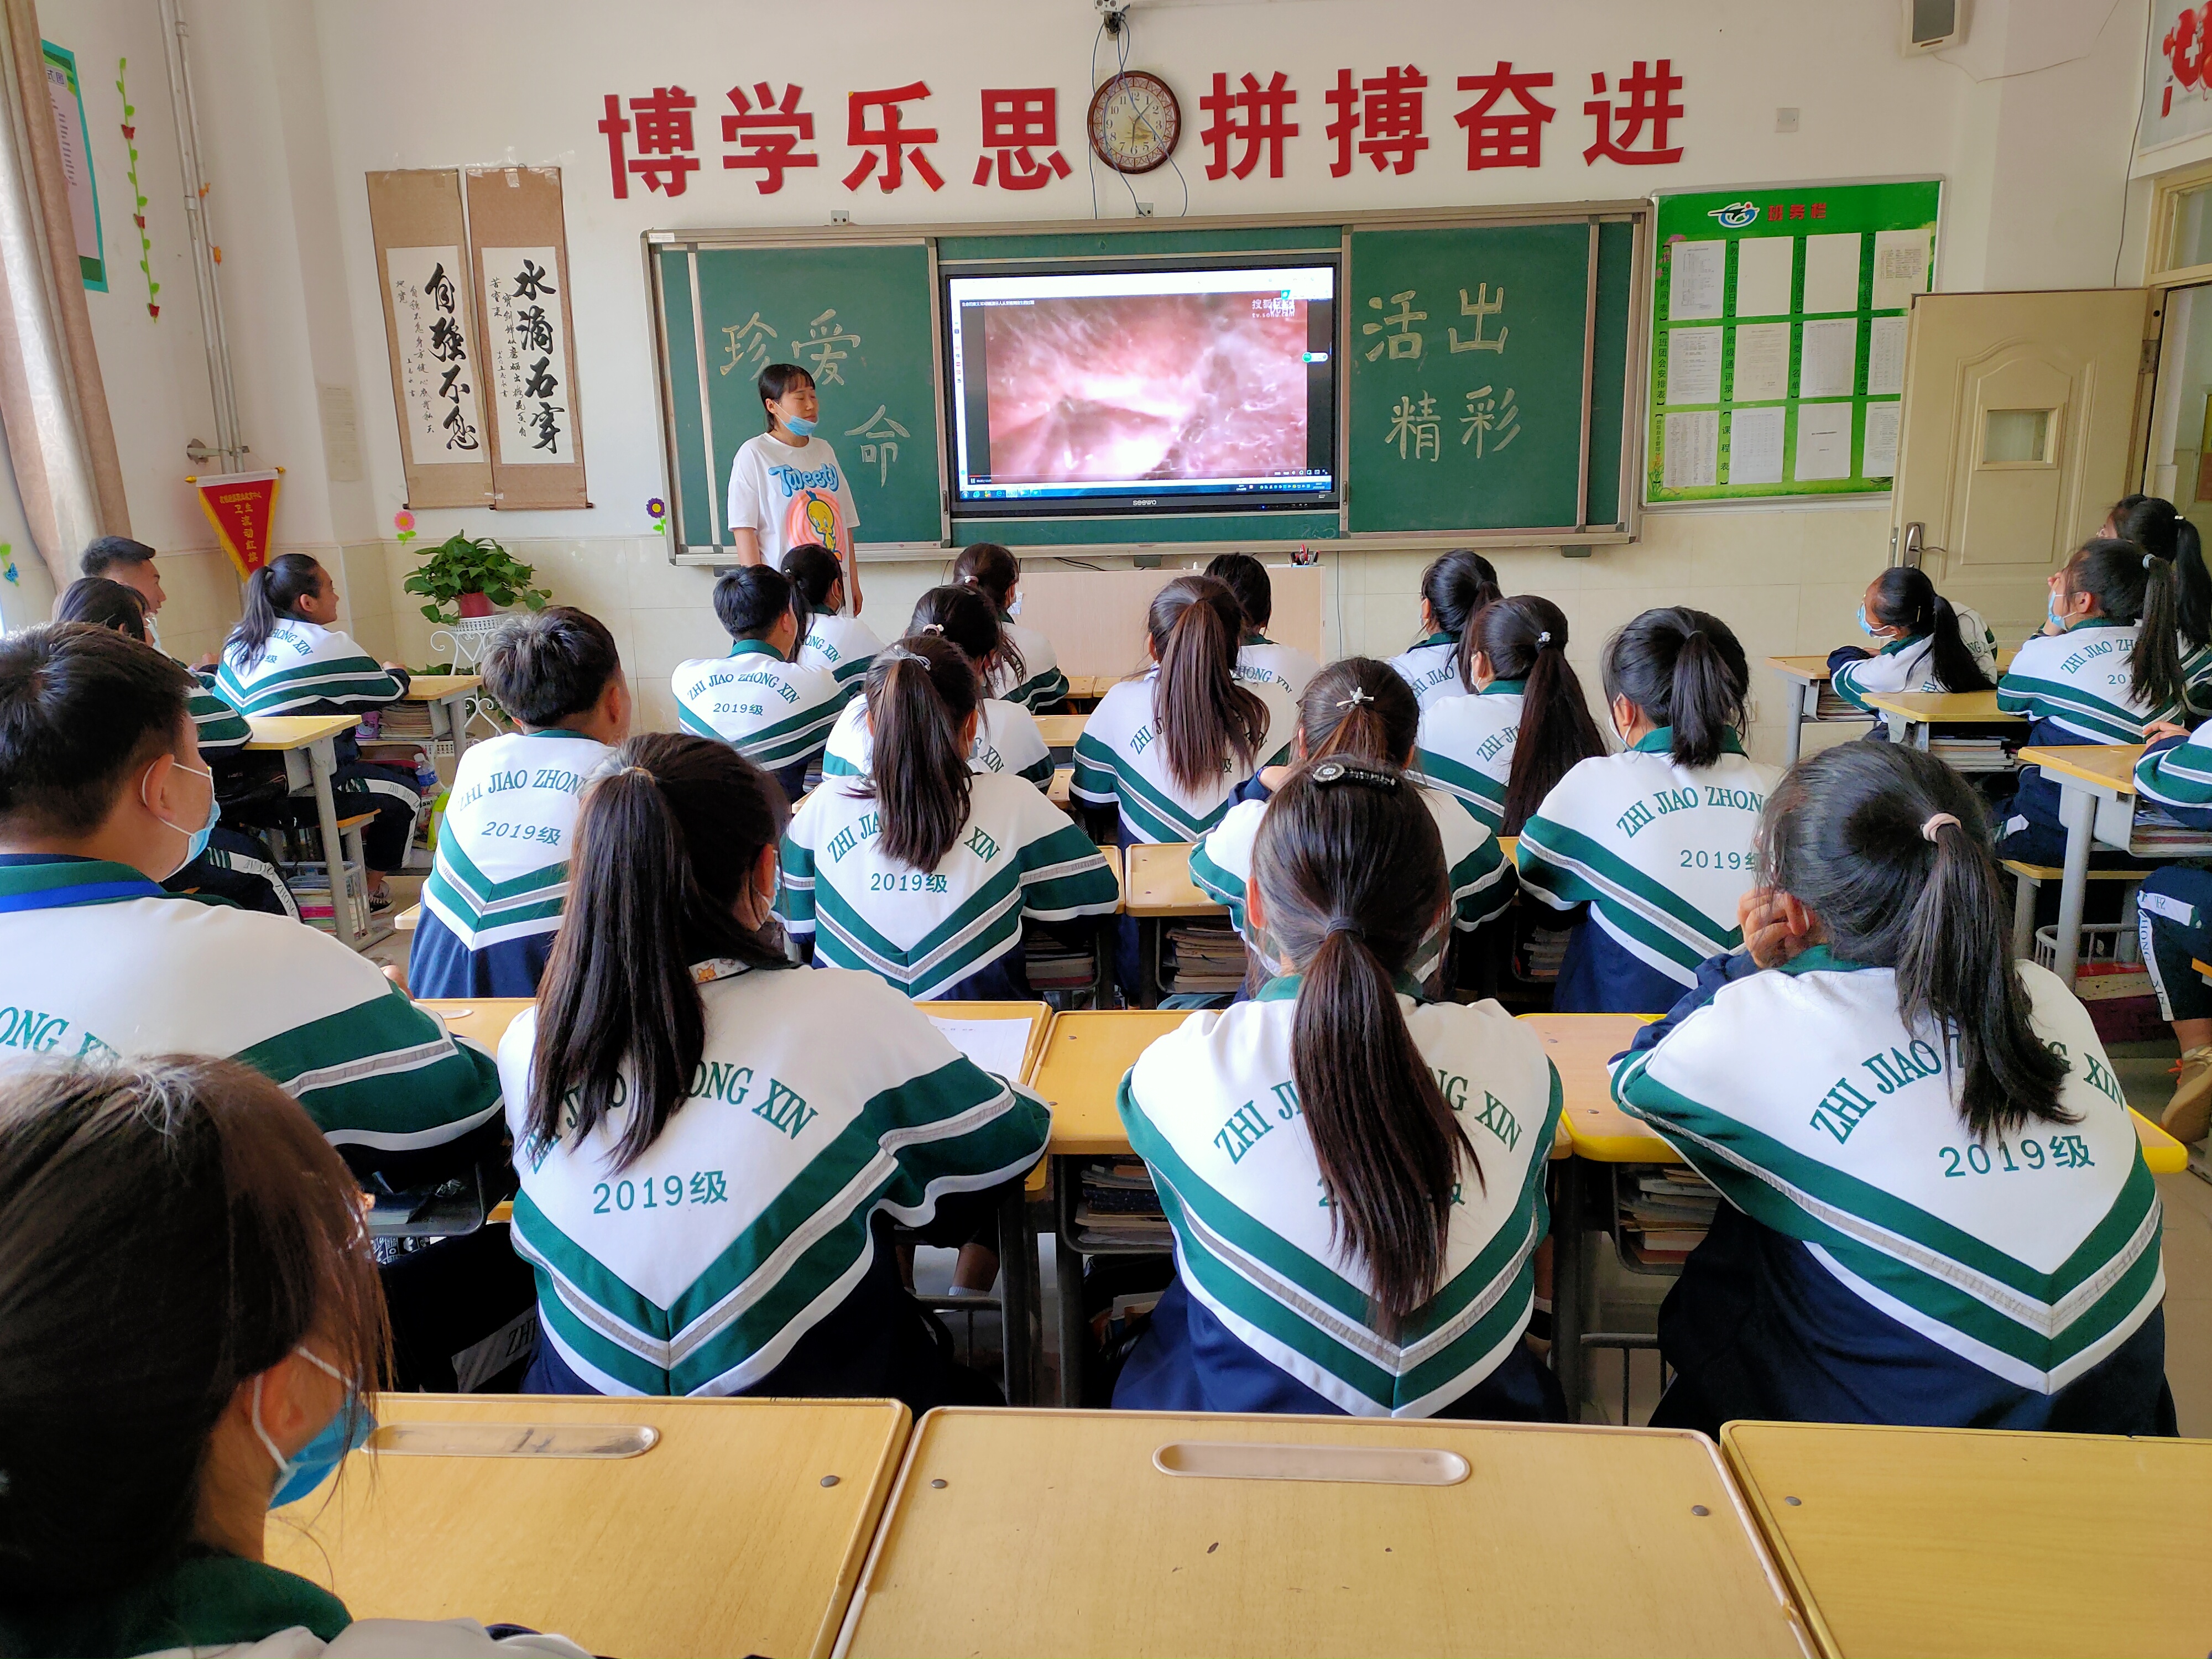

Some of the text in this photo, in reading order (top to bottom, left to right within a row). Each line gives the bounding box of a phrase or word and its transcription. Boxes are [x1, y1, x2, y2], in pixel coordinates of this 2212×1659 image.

[1120, 96, 1126, 105] 11
[1145, 96, 1149, 105] 1
[1152, 106, 1159, 114] 2
[598, 59, 1685, 199] 博学乐思 拼搏奋进
[1106, 119, 1113, 128] 9
[1110, 132, 1117, 141] 8
[1156, 121, 1162, 129] 3
[1119, 142, 1125, 151] 7
[1130, 145, 1138, 154] 6
[1142, 142, 1149, 150] 5
[1768, 203, 1826, 221] 班务栏
[1363, 283, 1509, 362] 活出
[721, 309, 860, 385] 珍爱
[1385, 385, 1521, 462] 精彩
[844, 404, 911, 488] 命
[768, 463, 839, 497] Tweety
[293, 639, 314, 656] XIN
[804, 635, 841, 662] ONG XIN
[2060, 653, 2087, 674] ZHI
[2083, 641, 2113, 659] JIAO
[687, 672, 800, 704] ZHI JIAO ZHONG XIN
[1426, 665, 1454, 686] JIAO
[713, 703, 763, 716] 2019级
[1130, 726, 1154, 755] ZHI
[1476, 734, 1505, 762] ZHI
[980, 745, 1004, 773] XIN
[458, 769, 586, 811] ZHI JIAO ZHON
[1616, 786, 1764, 838] ZHI JIAO ZHON
[481, 822, 561, 846] 2019级
[827, 811, 1000, 863] ZHI JIA XIN
[870, 873, 948, 893] 2019级
[0, 1006, 69, 1054] ONG
[1809, 1078, 1877, 1145] ZHI
[1862, 1040, 1942, 1095] JIAO
[2083, 1052, 2124, 1112] XIN
[752, 1078, 819, 1140] XIN
[1214, 1100, 1274, 1164] ZHI
[1474, 1091, 1522, 1153] XIN
[1939, 1135, 2095, 1178] 2019级
[593, 1170, 728, 1214] 2019级
